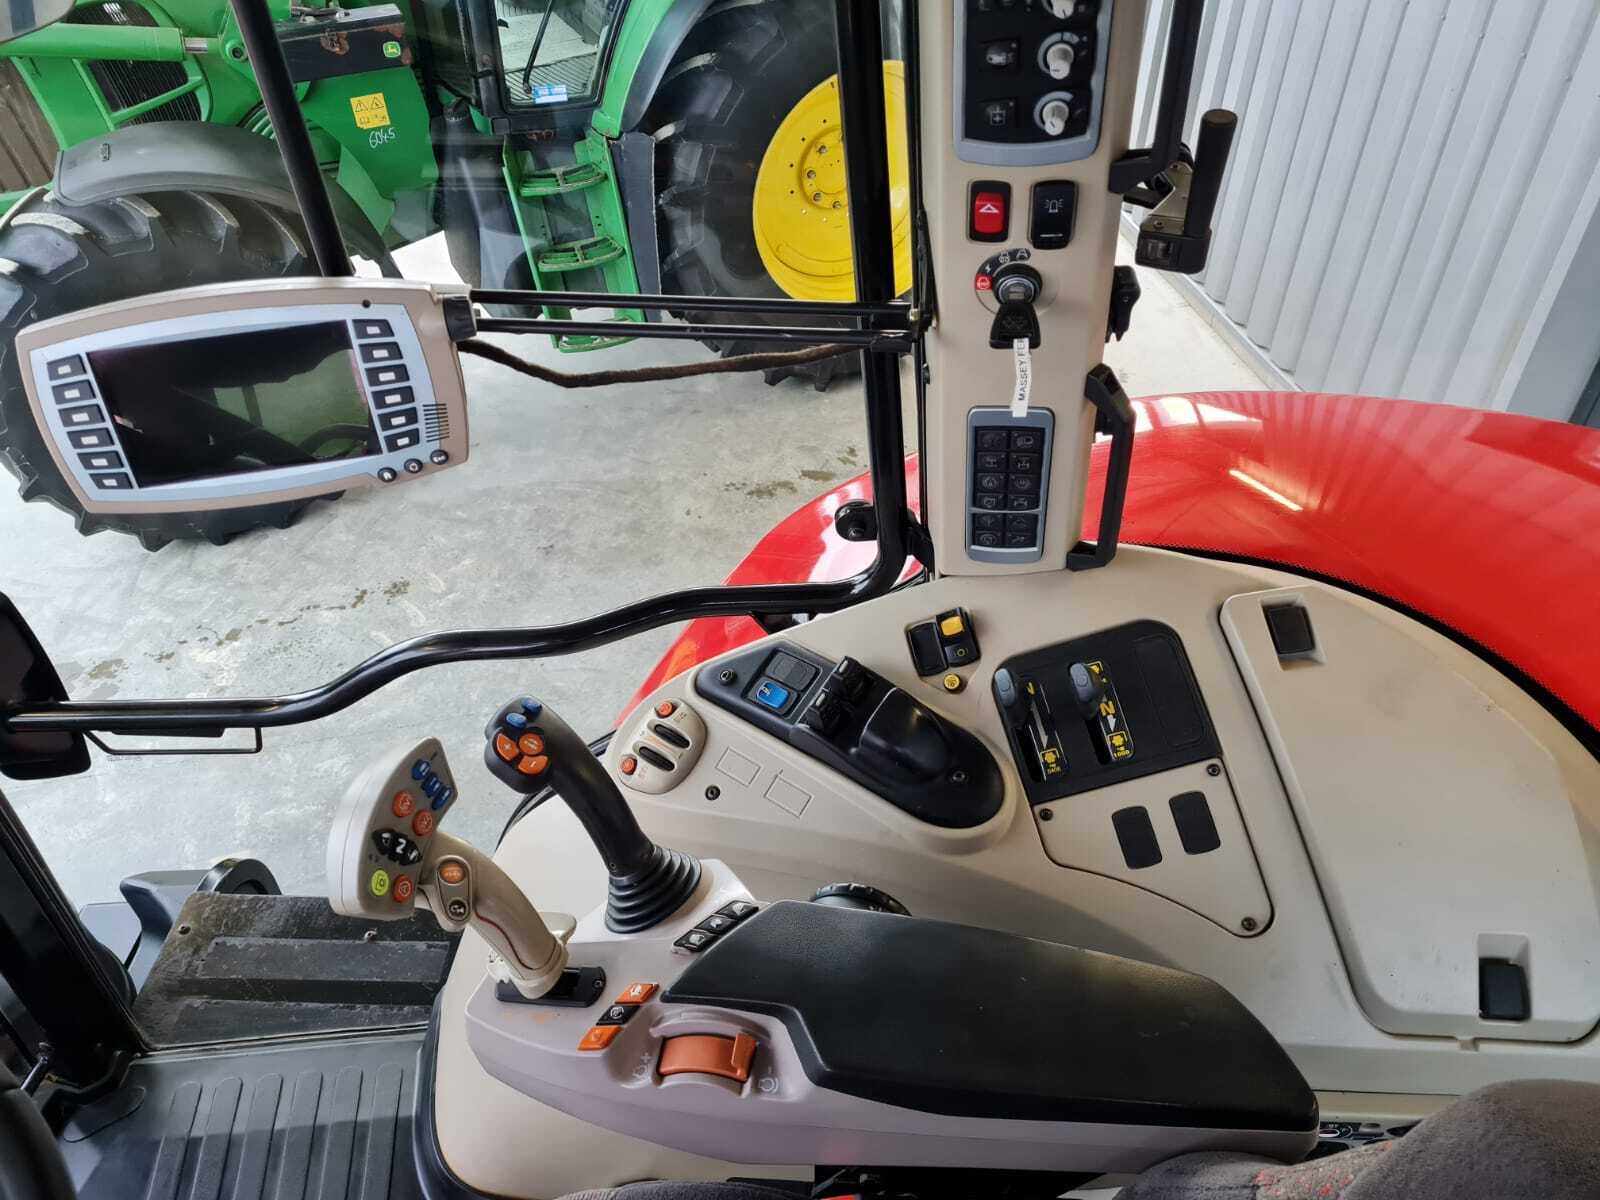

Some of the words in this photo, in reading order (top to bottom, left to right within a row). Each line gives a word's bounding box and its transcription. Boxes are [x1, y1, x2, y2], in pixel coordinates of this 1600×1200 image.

[1017, 359, 1028, 401] MASSEY
[1099, 700, 1116, 717] N
[395, 837, 407, 855] 2
